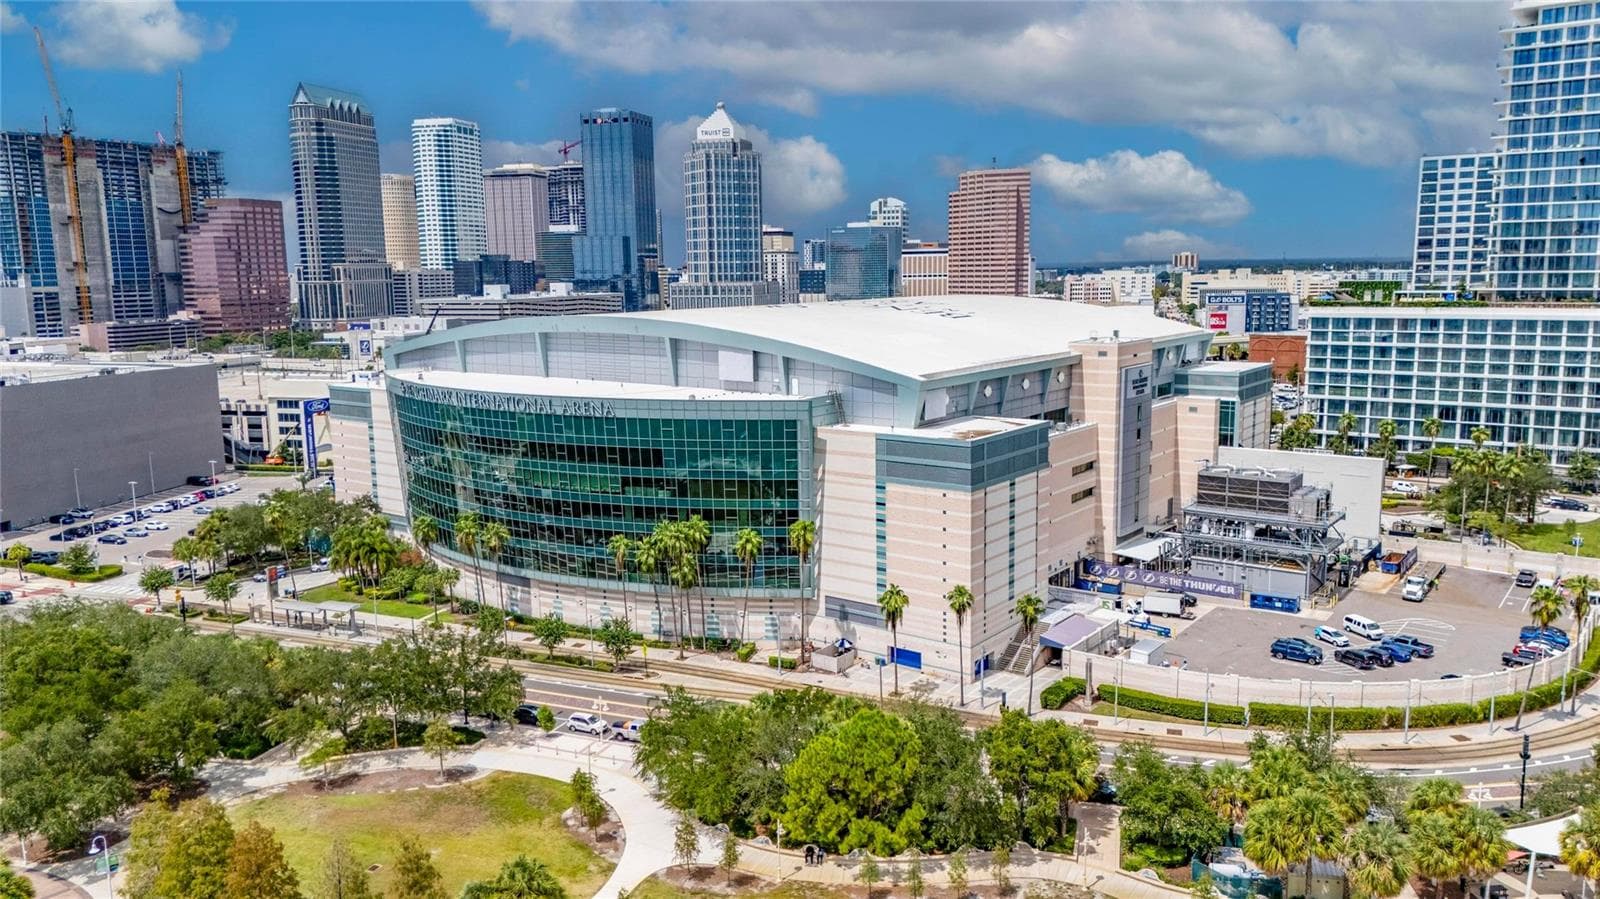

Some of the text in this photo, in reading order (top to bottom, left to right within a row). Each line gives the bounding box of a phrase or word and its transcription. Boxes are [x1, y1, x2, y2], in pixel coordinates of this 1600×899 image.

[310, 401, 325, 411] Ford
[455, 391, 554, 414] INTERNATIONAL
[562, 399, 616, 416] ARENA
[1159, 576, 1235, 595] BE THE THUNDER
